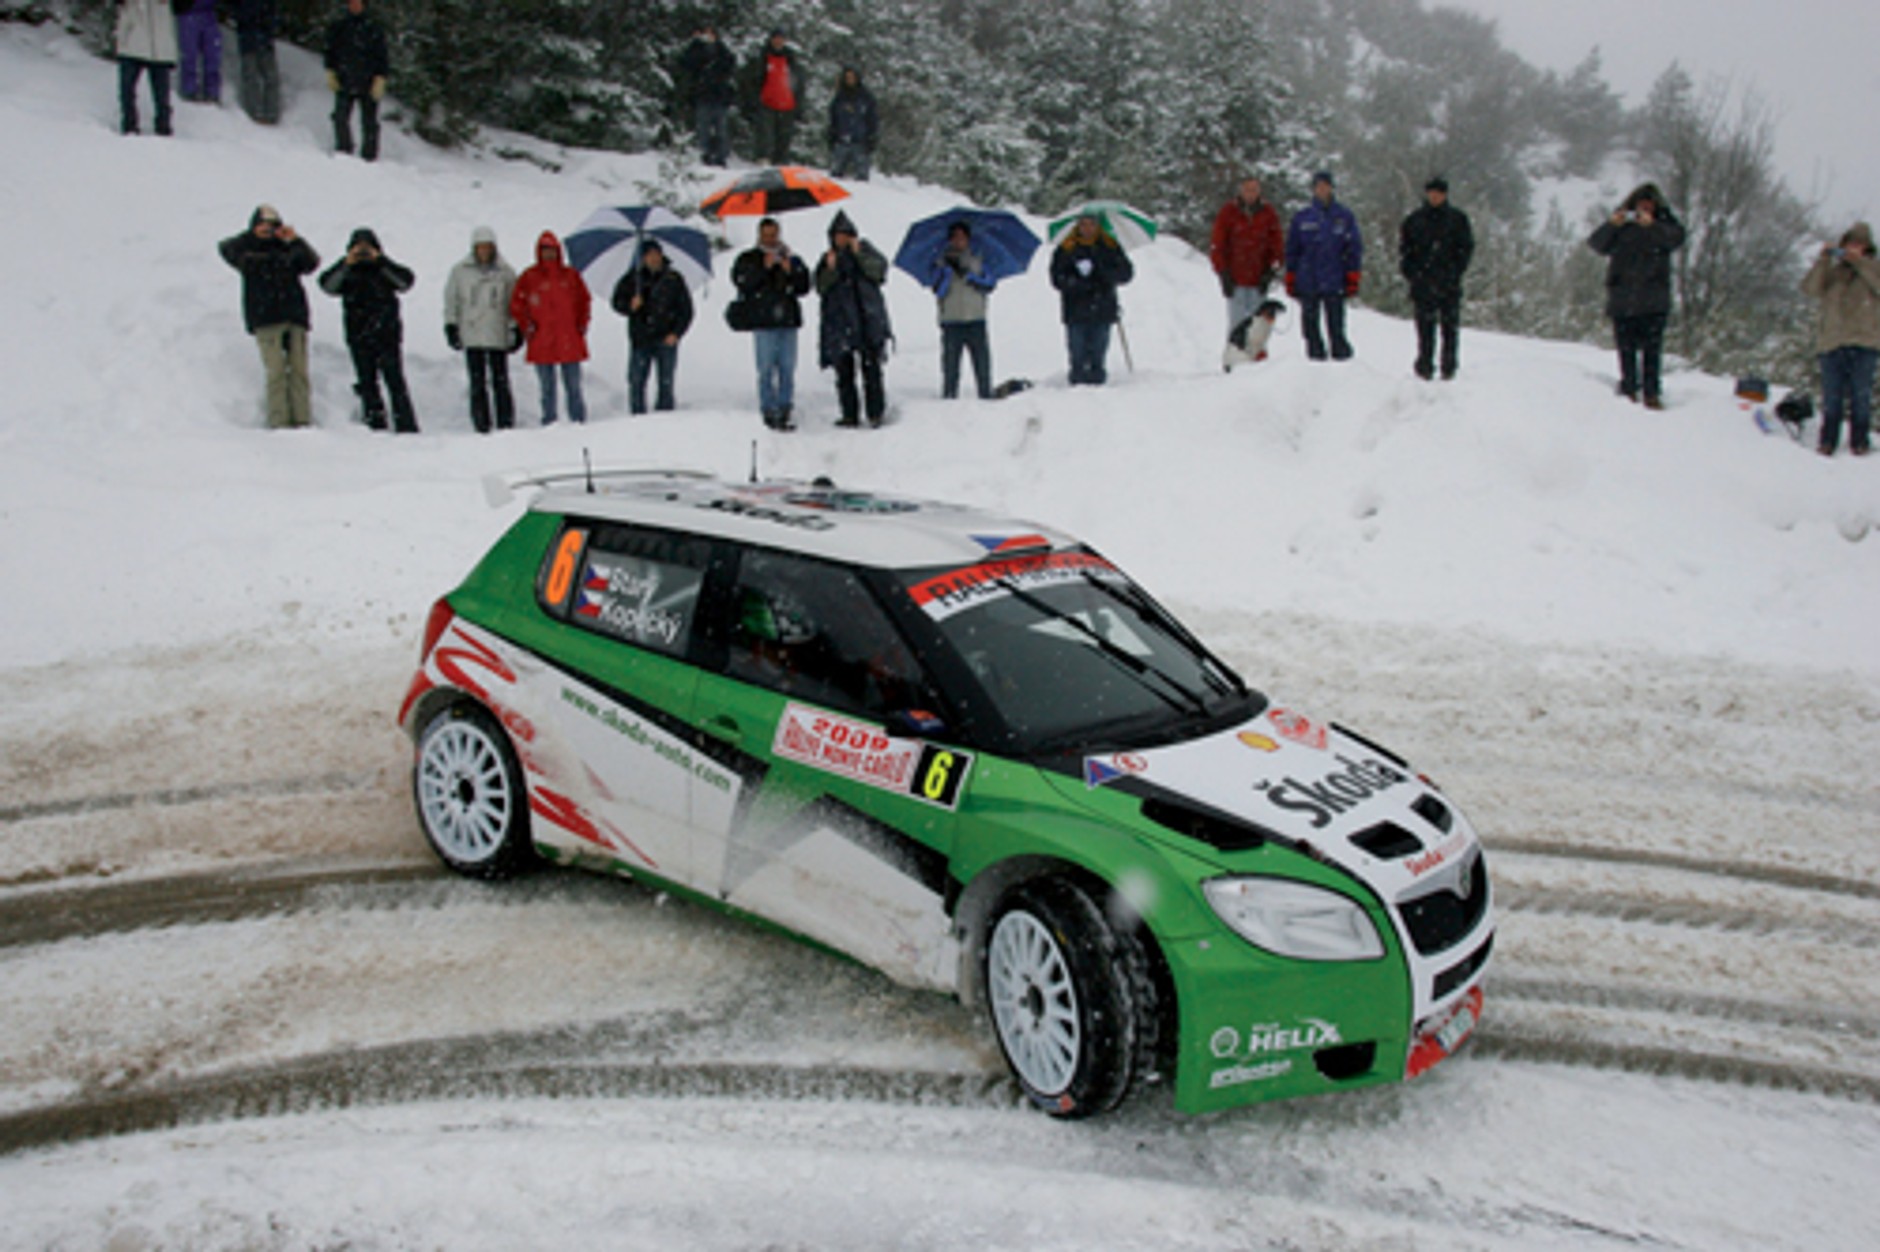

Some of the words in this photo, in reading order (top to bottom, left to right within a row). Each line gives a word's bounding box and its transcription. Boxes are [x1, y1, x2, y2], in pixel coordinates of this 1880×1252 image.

[545, 529, 583, 605] 6
[923, 751, 954, 799] 6
[1252, 752, 1396, 829] Škoda
[1249, 1022, 1342, 1052] HELIX
